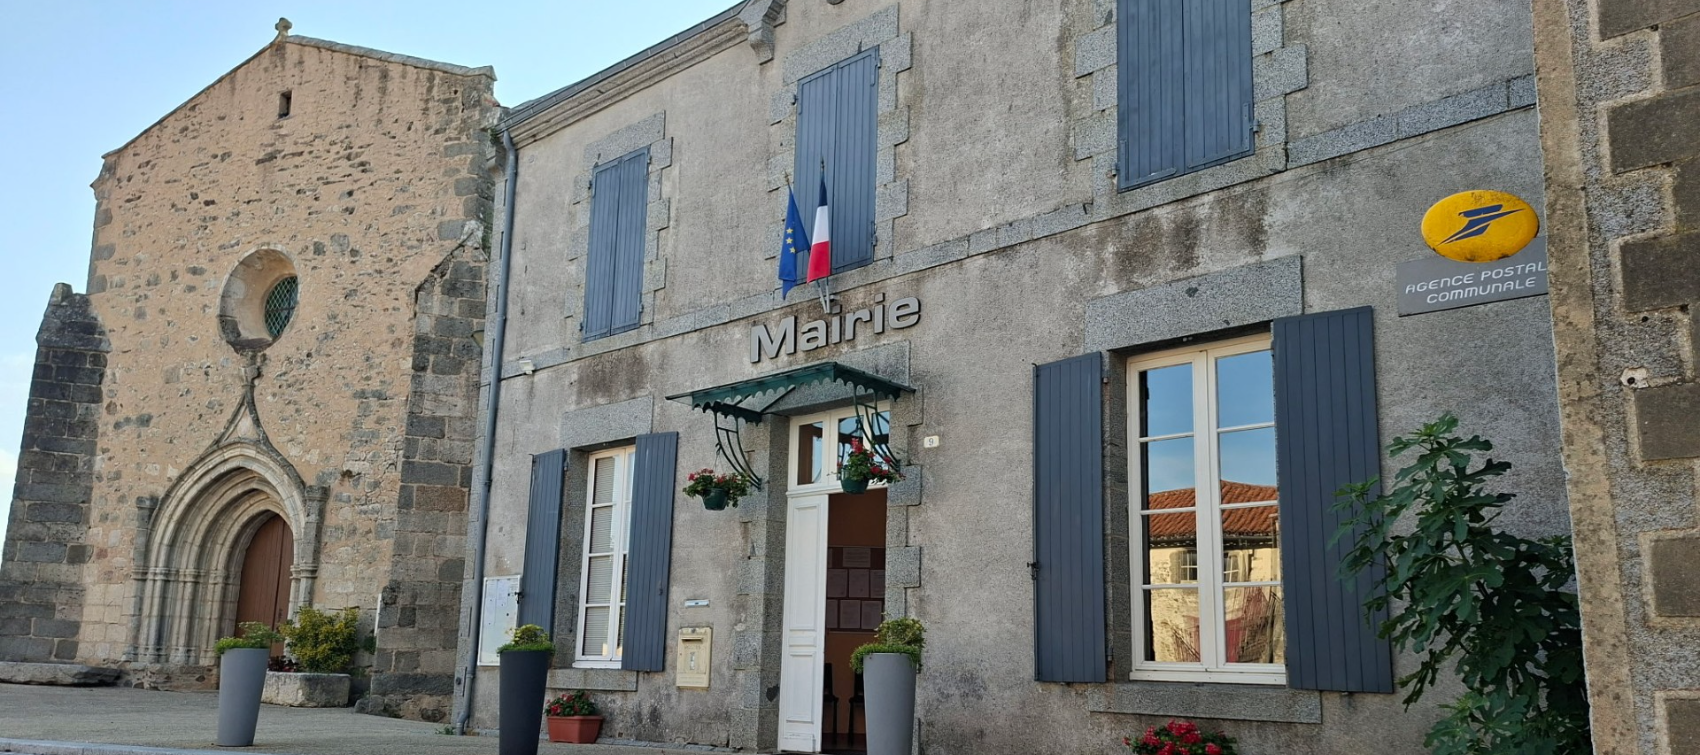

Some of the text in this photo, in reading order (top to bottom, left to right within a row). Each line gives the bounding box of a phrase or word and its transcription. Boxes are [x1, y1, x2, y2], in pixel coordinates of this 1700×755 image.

[1405, 262, 1547, 294] AGENCE POSTAL
[1426, 277, 1536, 304] COMMUNALE
[751, 293, 920, 363] Mairie
